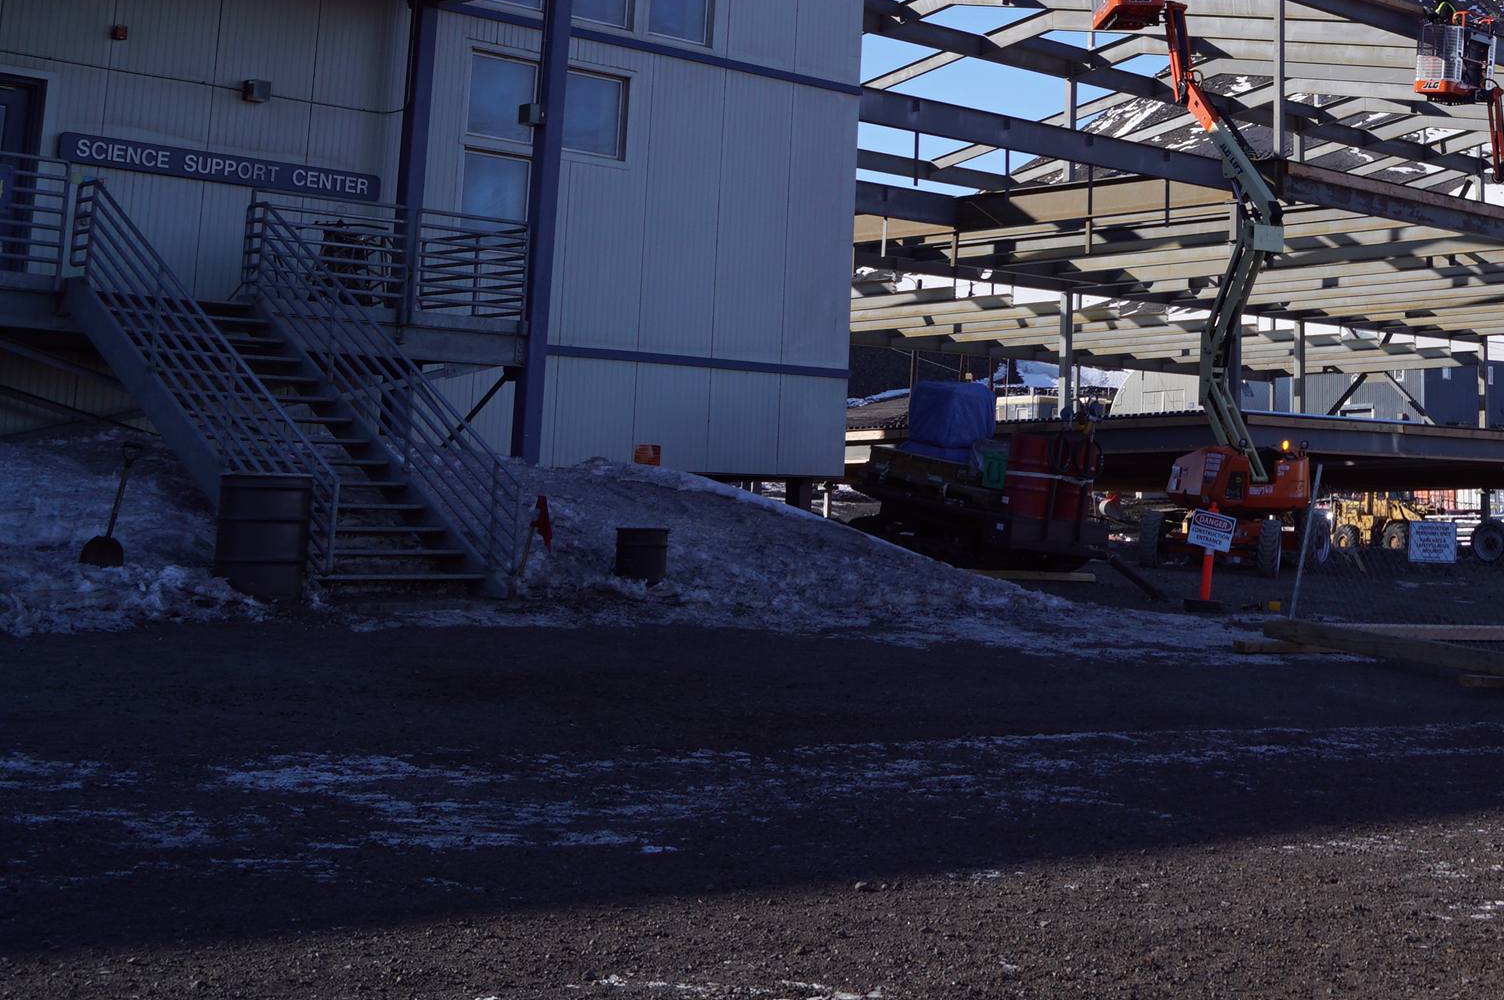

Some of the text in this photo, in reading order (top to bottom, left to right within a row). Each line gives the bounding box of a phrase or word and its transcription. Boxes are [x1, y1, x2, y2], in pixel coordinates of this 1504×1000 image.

[1422, 81, 1441, 89] JLG
[1218, 144, 1244, 174] JLG LIFT
[76, 139, 368, 194] SCIENCE SUPPORT CENTER
[1200, 516, 1228, 528] DANGER
[1192, 526, 1230, 540] CONSTRUCTION
[1196, 534, 1222, 545] ENTRANCE
